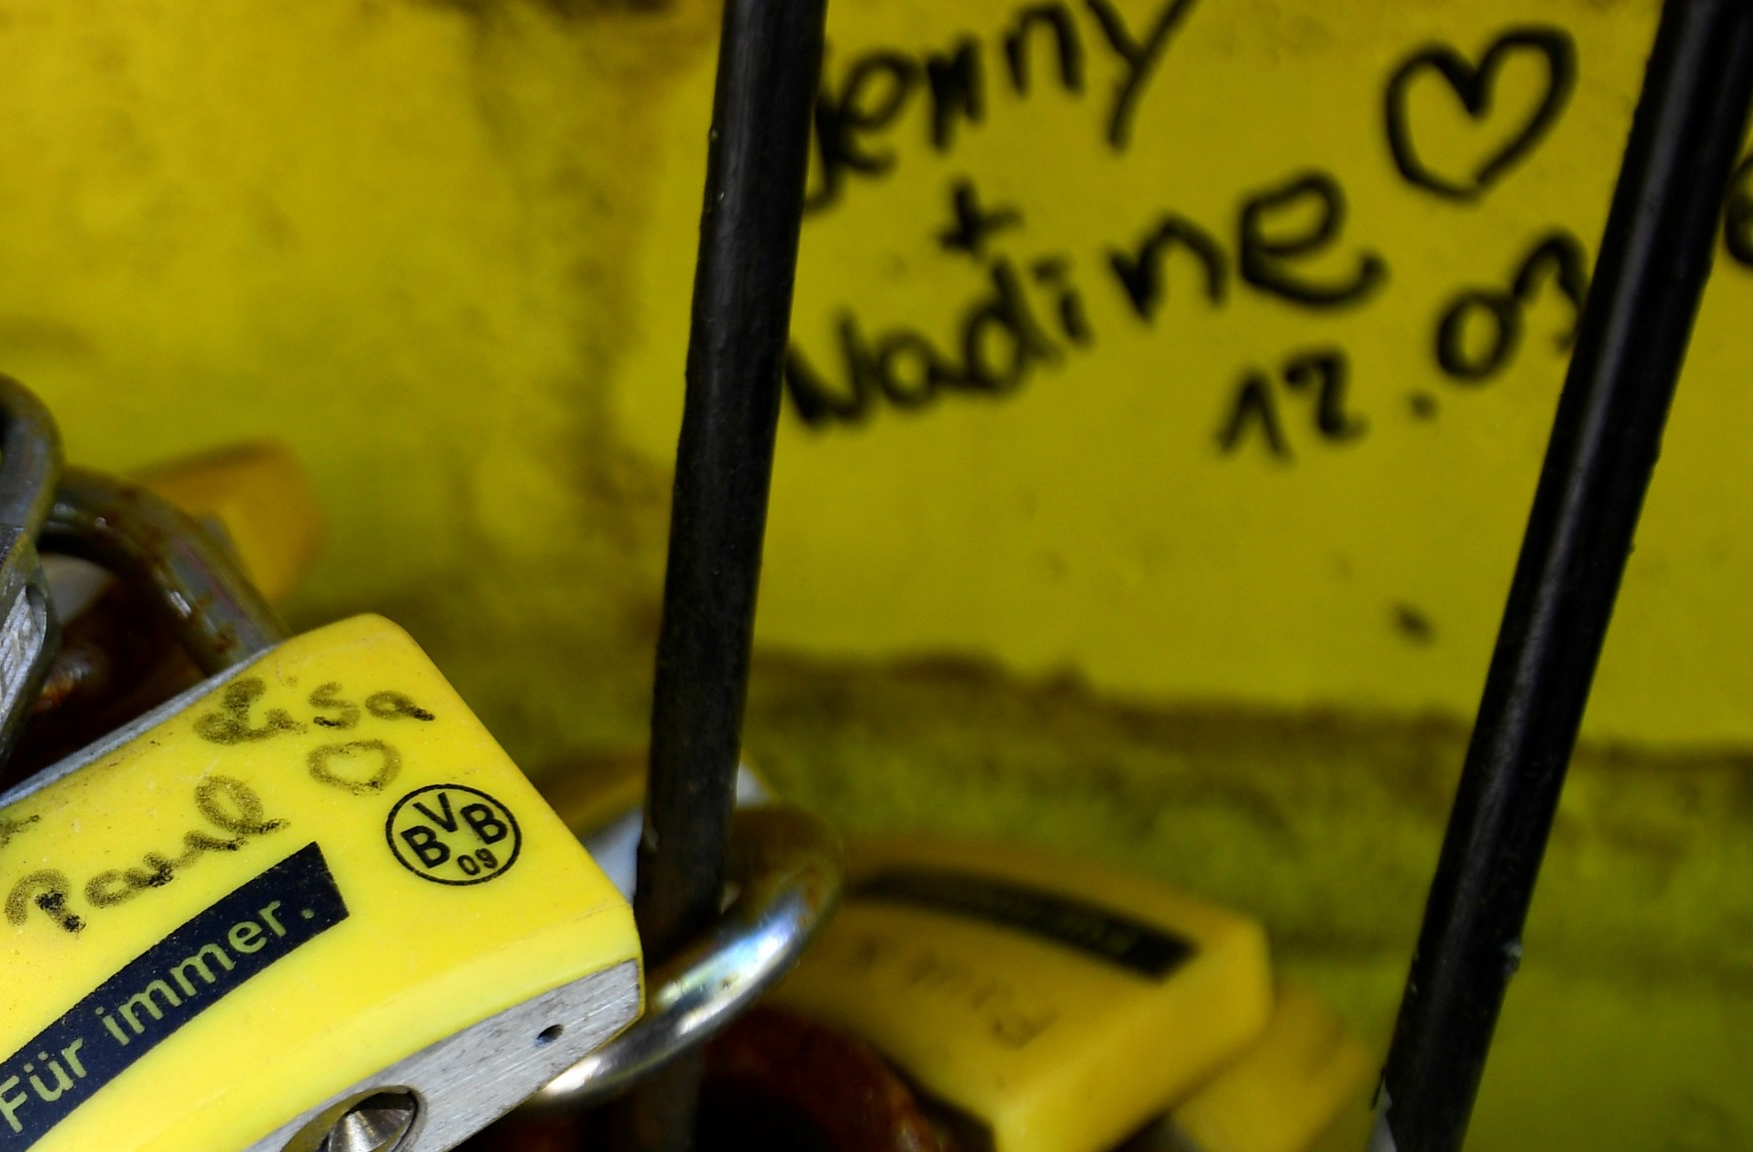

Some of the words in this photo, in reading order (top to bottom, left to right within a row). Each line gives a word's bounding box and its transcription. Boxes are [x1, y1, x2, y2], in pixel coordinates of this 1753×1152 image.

[400, 791, 508, 869] BVB
[457, 847, 498, 876] 09
[105, 895, 316, 1047] immer.
